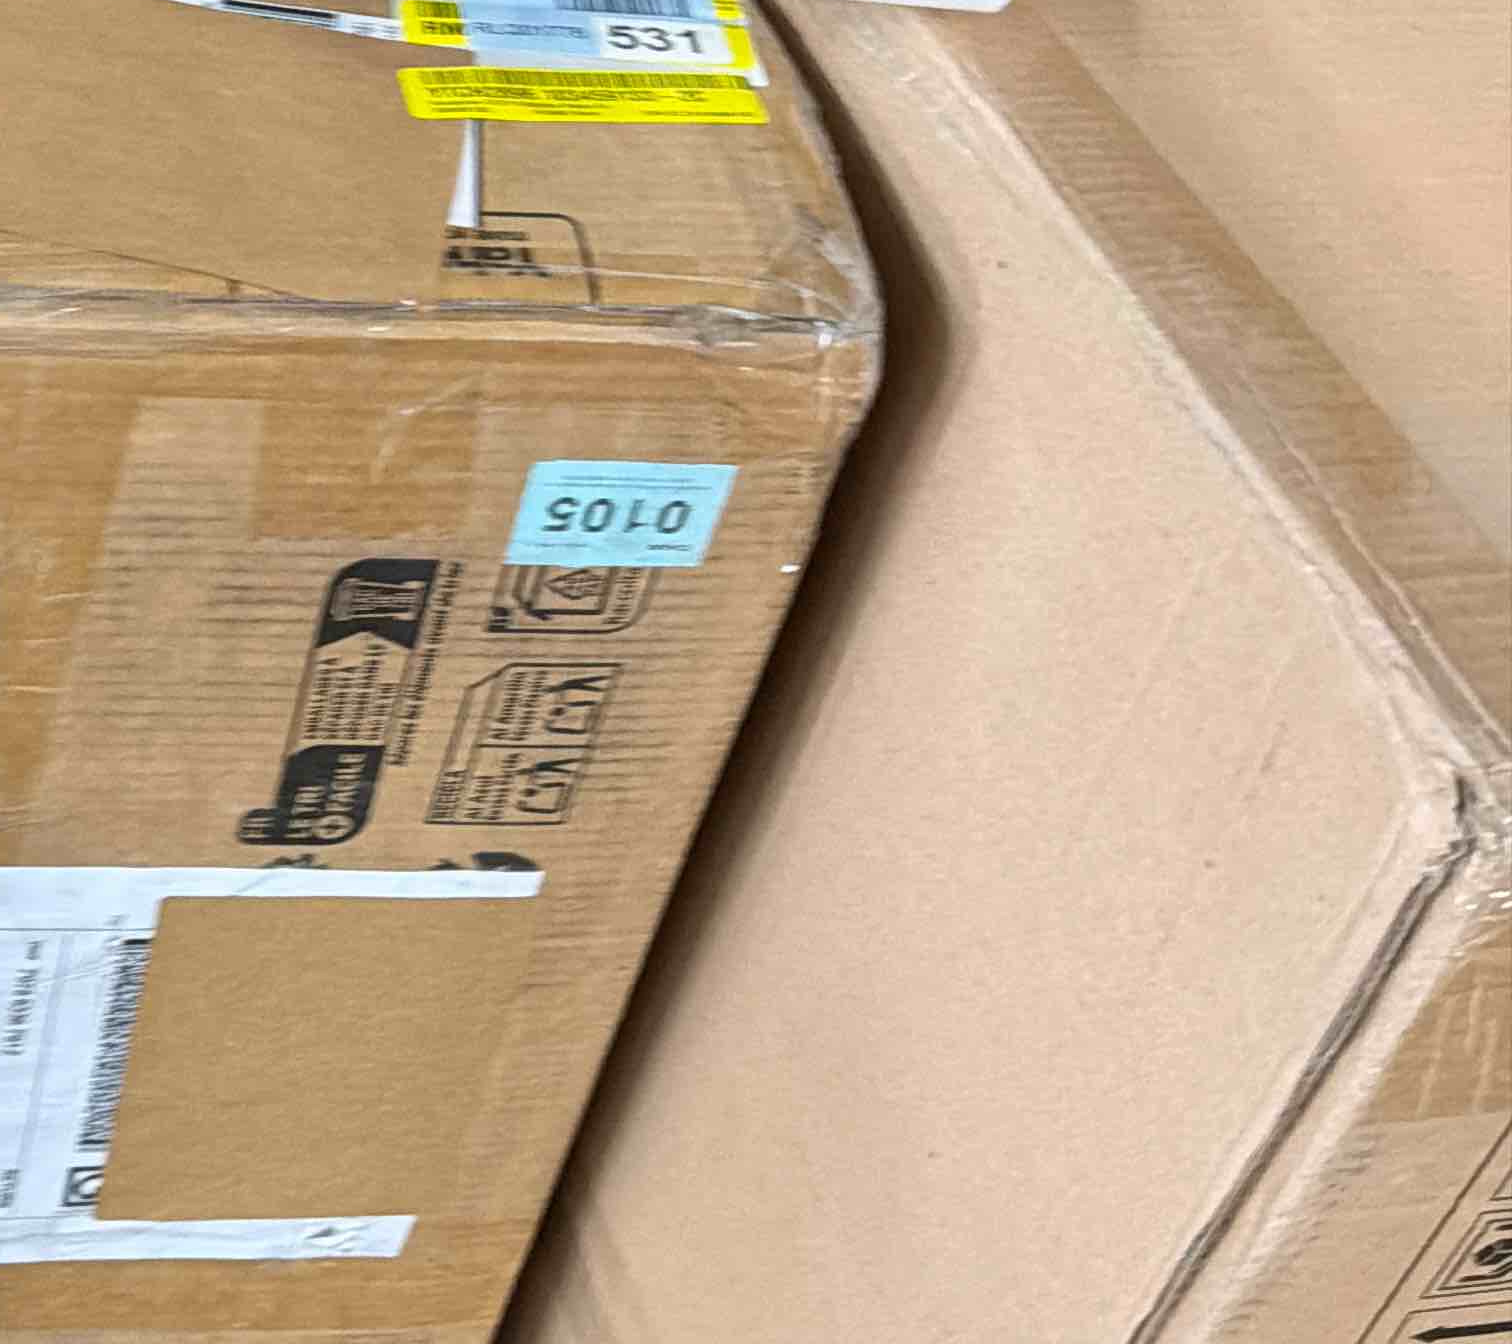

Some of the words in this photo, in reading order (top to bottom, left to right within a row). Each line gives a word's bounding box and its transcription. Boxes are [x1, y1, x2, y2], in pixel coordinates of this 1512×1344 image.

[606, 23, 703, 56] 531
[542, 496, 696, 535] 0105
[325, 752, 368, 812] FACILE
[290, 785, 326, 816] TRI
